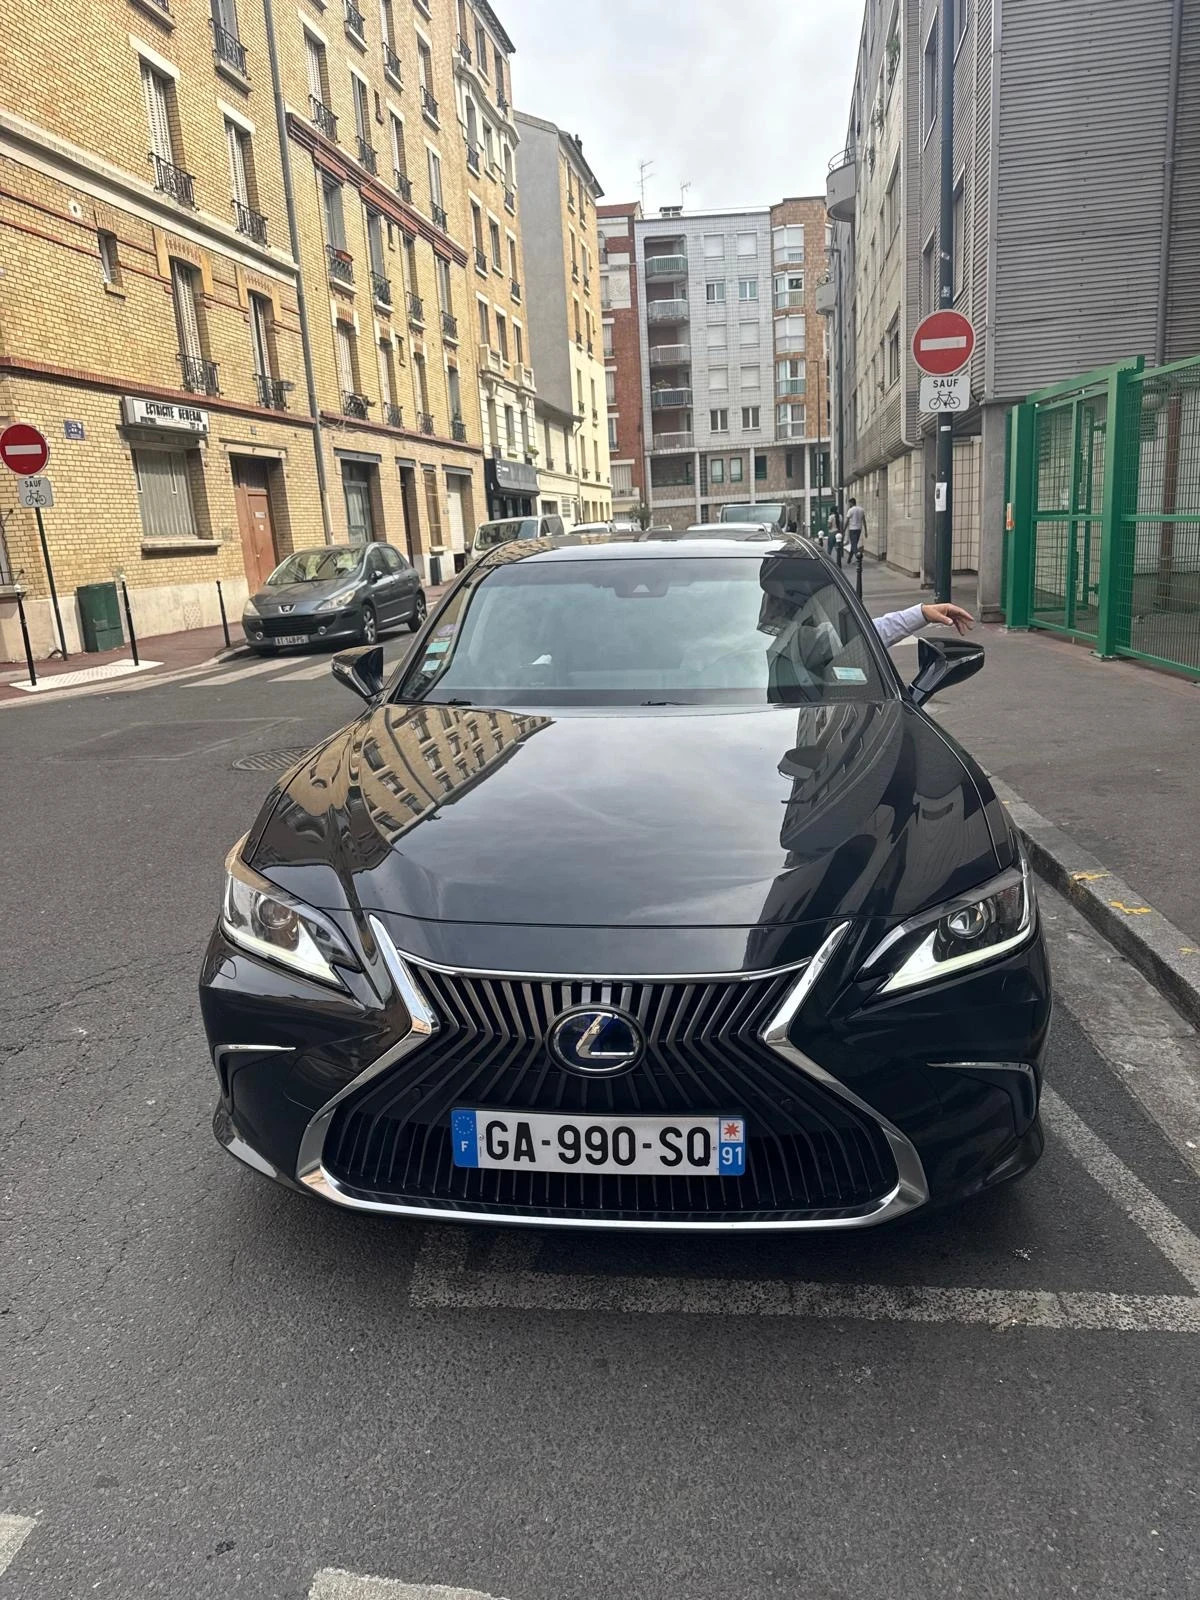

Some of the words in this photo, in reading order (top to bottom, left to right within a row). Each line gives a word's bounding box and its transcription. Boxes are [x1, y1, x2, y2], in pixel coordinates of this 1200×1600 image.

[933, 378, 959, 388] SAUF
[24, 480, 42, 488] SAUF
[461, 1140, 470, 1153] F
[485, 1120, 711, 1167] GA-990-SQ
[722, 1146, 743, 1166] 91
